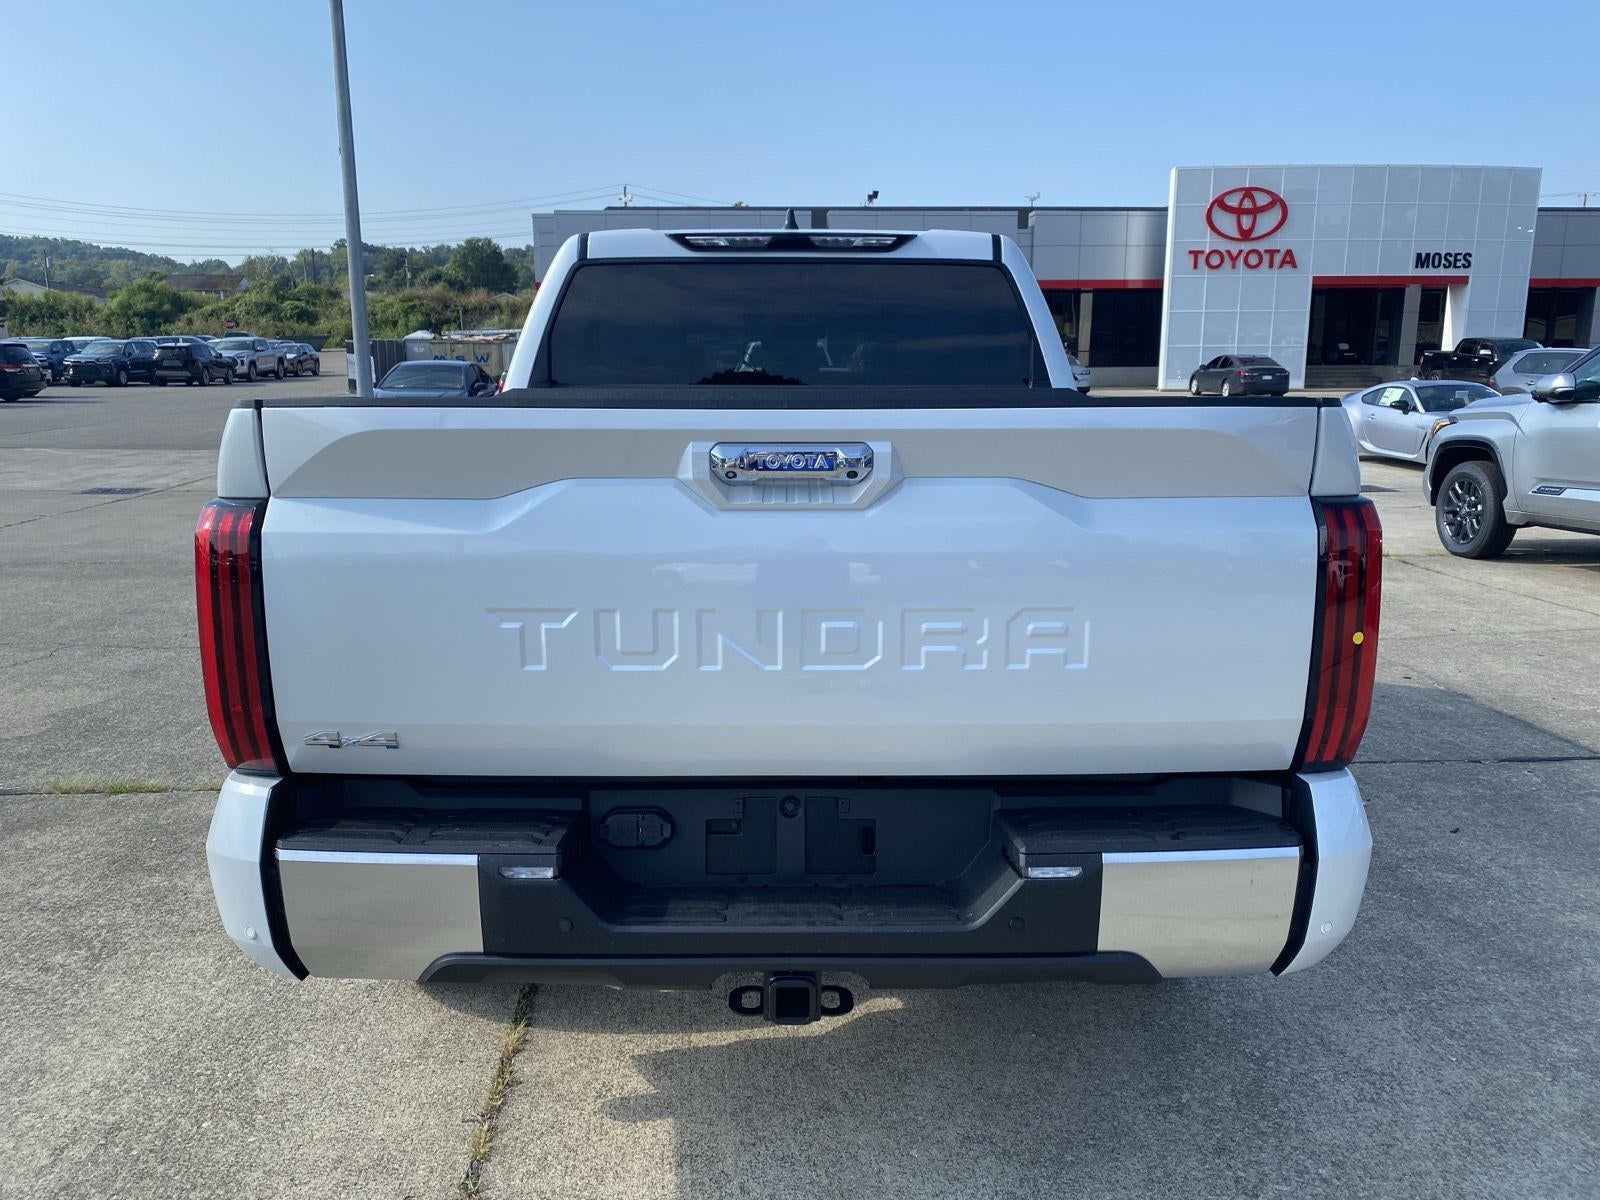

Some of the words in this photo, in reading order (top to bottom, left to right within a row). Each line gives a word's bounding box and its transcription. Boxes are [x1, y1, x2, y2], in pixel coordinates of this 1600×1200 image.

[1188, 249, 1297, 269] TOYOTA
[1415, 252, 1473, 269] MOSES
[756, 453, 829, 469] TOYOTA
[484, 608, 1091, 671] TUNDRA
